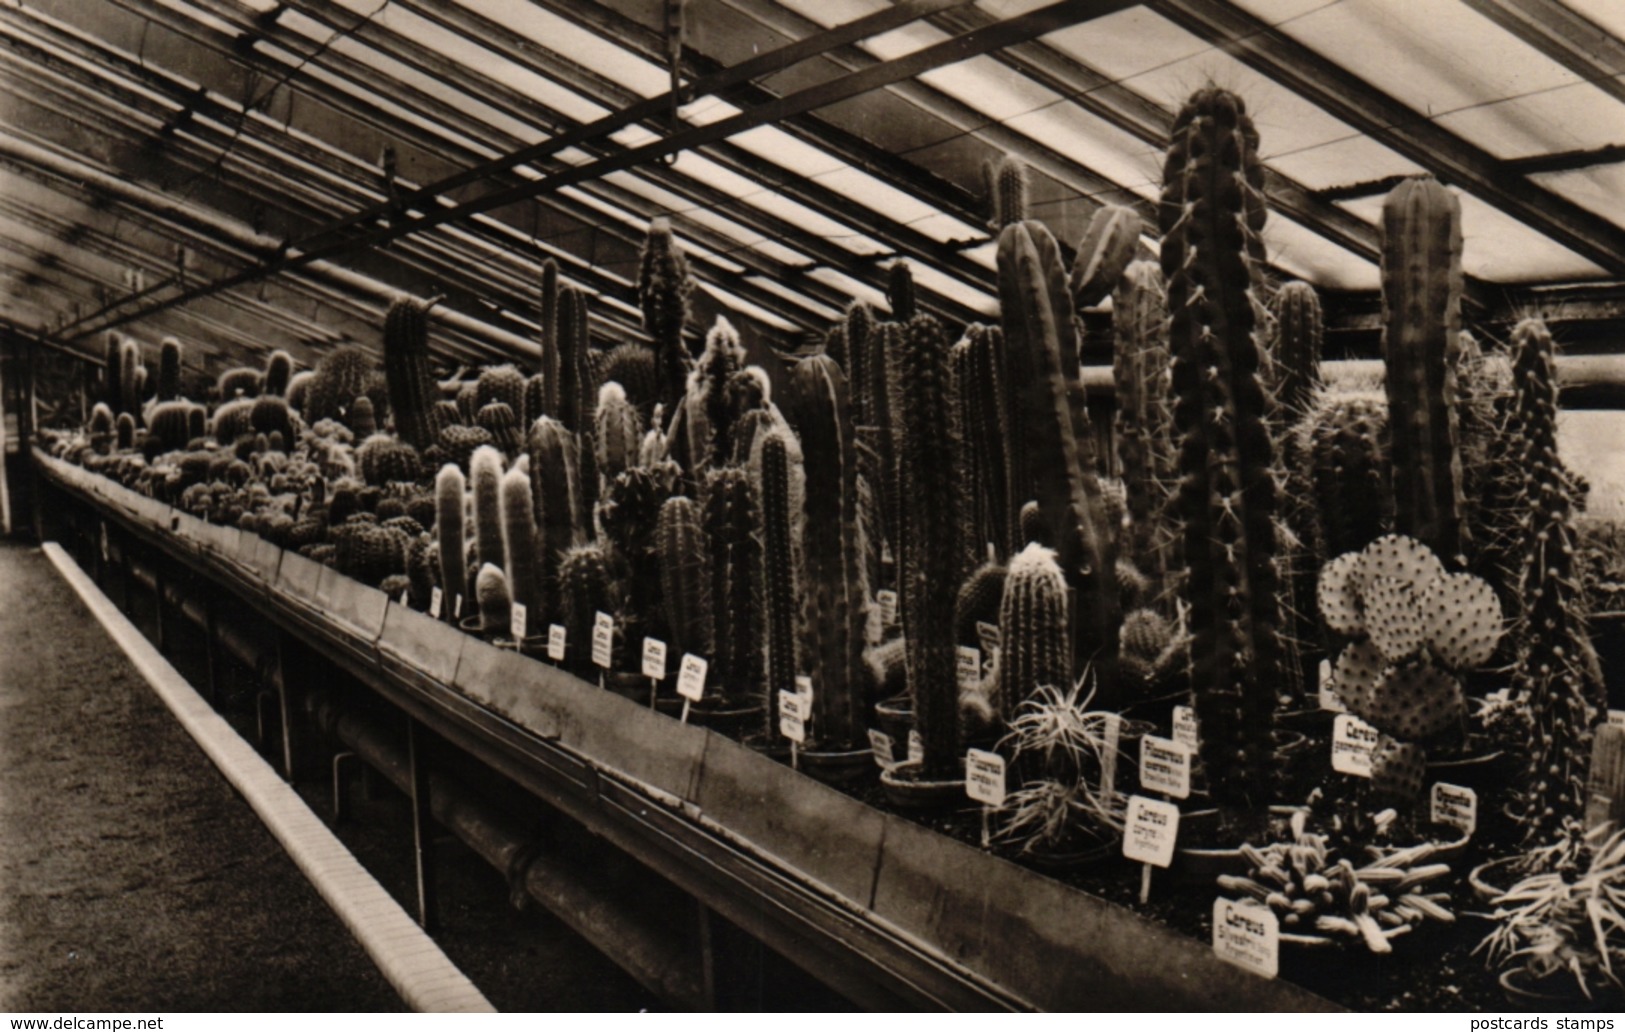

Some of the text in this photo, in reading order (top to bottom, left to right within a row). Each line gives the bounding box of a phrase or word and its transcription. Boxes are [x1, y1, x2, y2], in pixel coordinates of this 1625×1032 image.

[1346, 721, 1377, 743] Cereu
[1137, 804, 1168, 826] Cereus
[1226, 905, 1265, 937] Cereus
